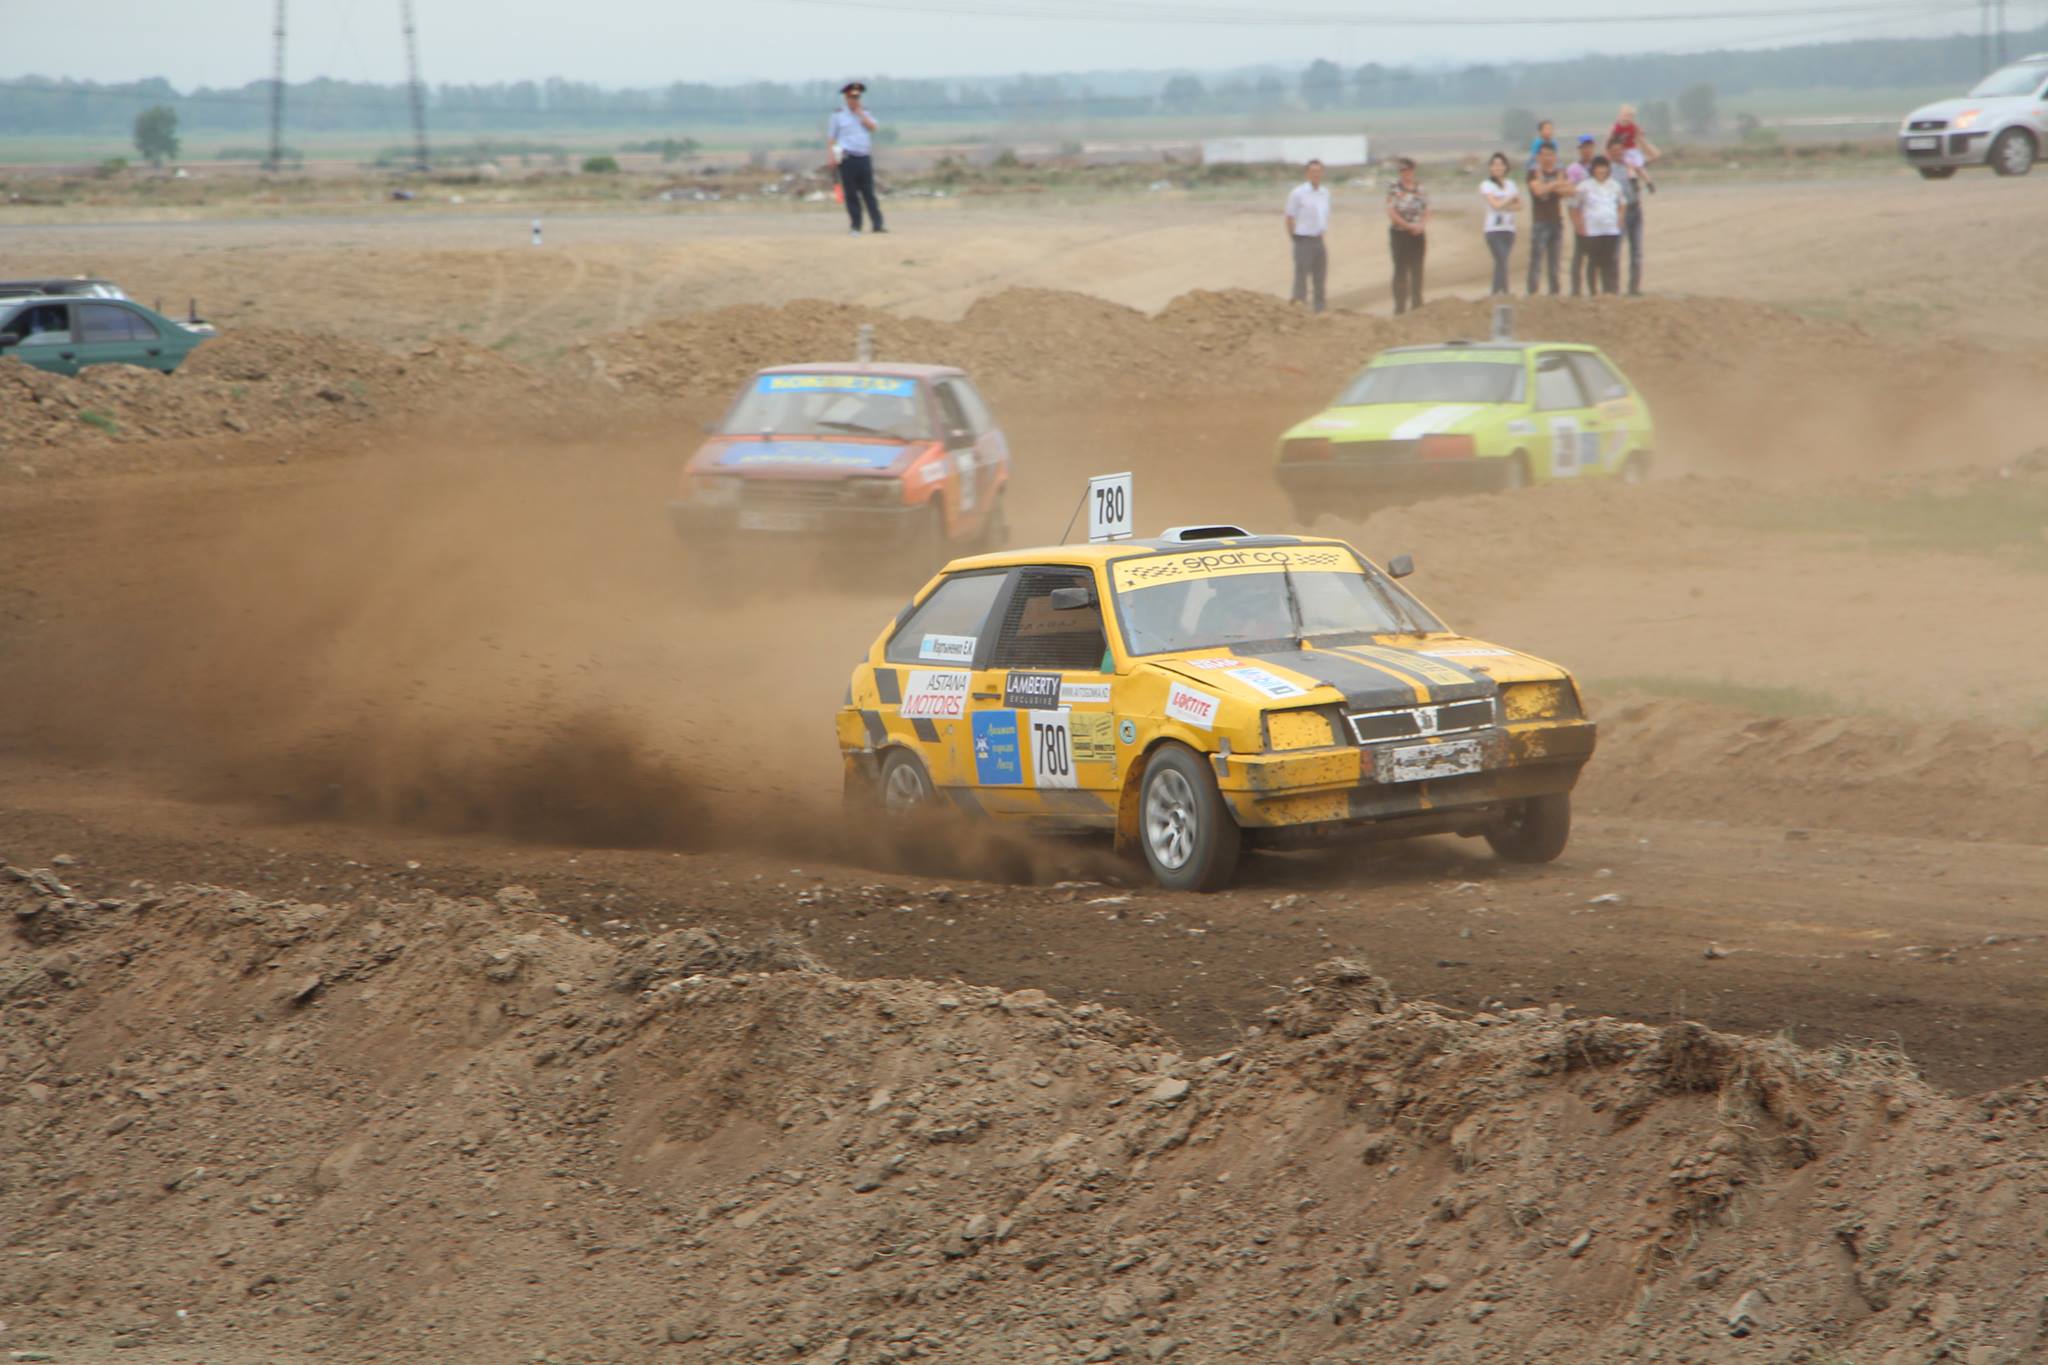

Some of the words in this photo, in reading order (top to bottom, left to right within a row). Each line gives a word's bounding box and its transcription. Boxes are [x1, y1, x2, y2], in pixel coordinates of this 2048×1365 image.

[1096, 485, 1125, 524] 780
[1182, 551, 1290, 572] sparco
[926, 674, 968, 691] ASTANA
[1006, 675, 1060, 696] LAMBERTY
[903, 694, 963, 715] MOTORS
[1009, 694, 1053, 706] EXCLUSIVE
[1172, 691, 1212, 718] LOCTITE
[1034, 723, 1069, 776] 780
